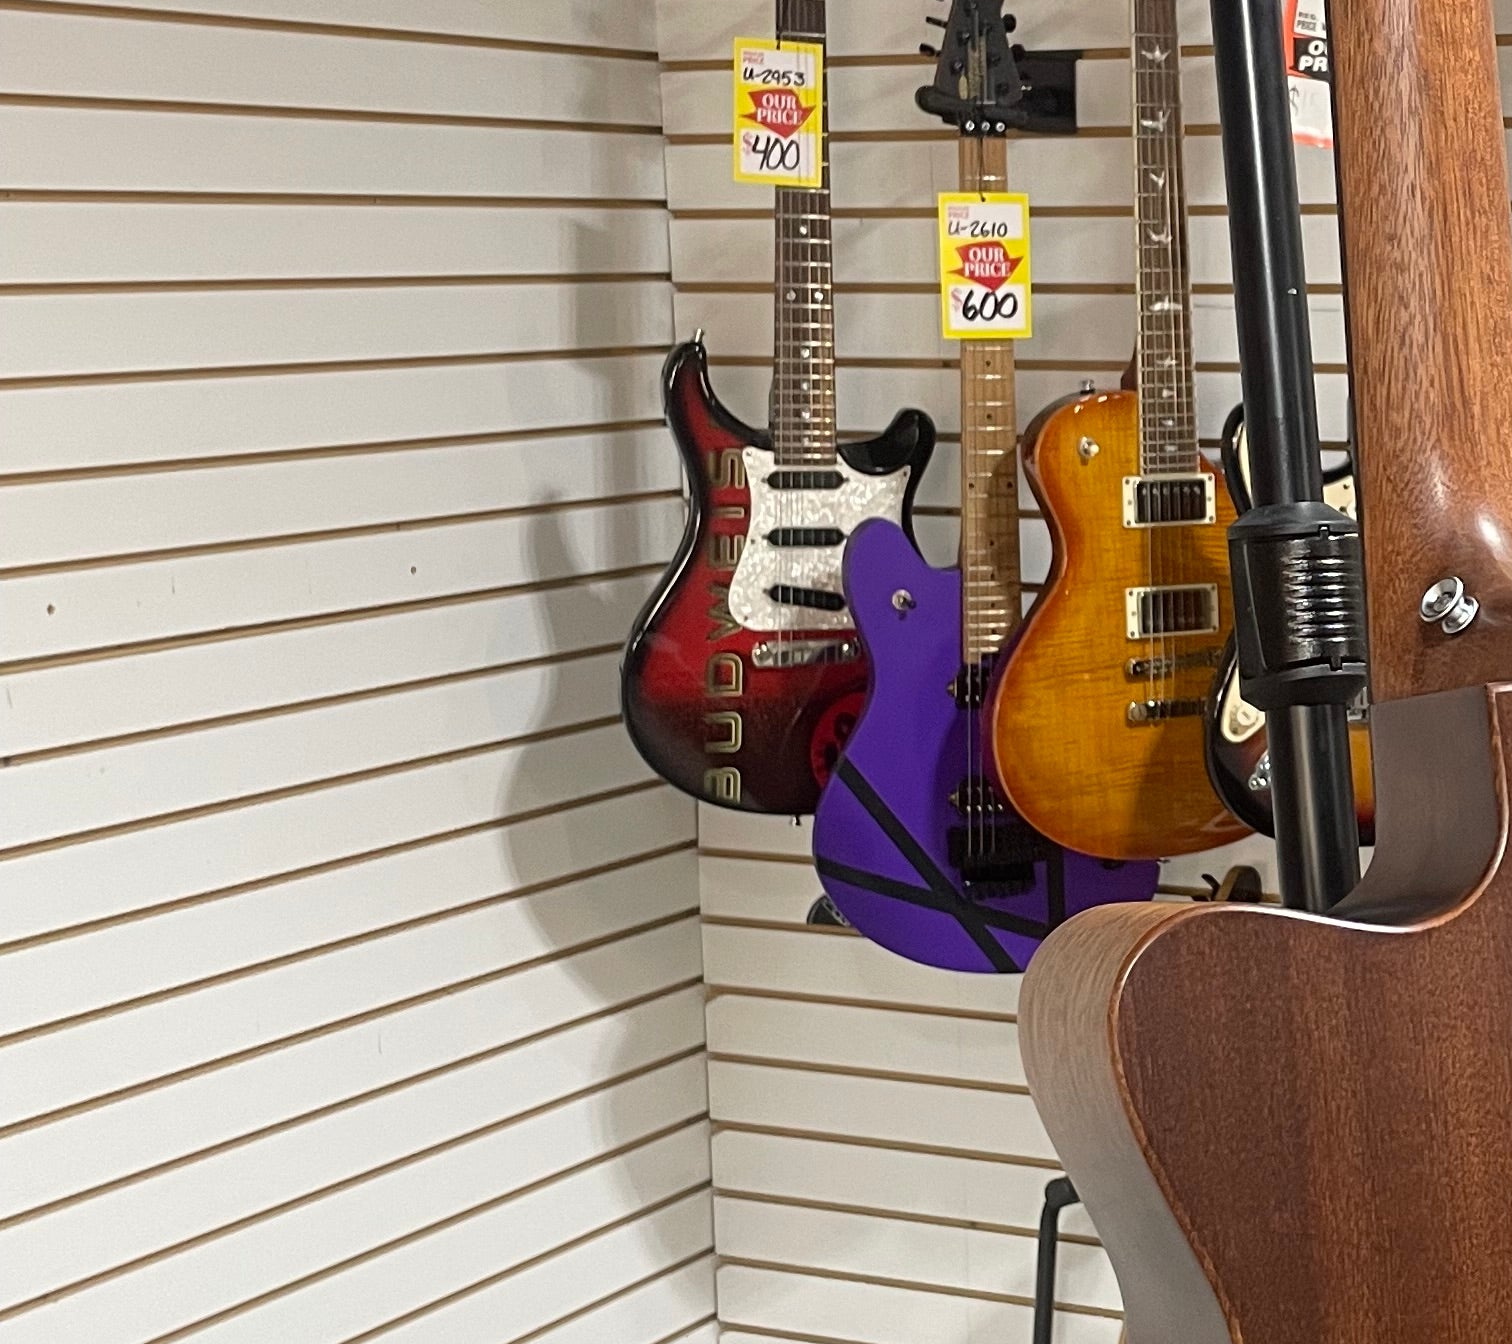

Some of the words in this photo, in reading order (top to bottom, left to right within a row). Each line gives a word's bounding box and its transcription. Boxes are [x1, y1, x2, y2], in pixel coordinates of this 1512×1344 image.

[761, 93, 797, 109] OUR
[756, 108, 803, 125] PRICE
[968, 246, 1005, 263] OUR
[964, 261, 1012, 278] PRICE
[704, 446, 748, 804] BUDWEIS
